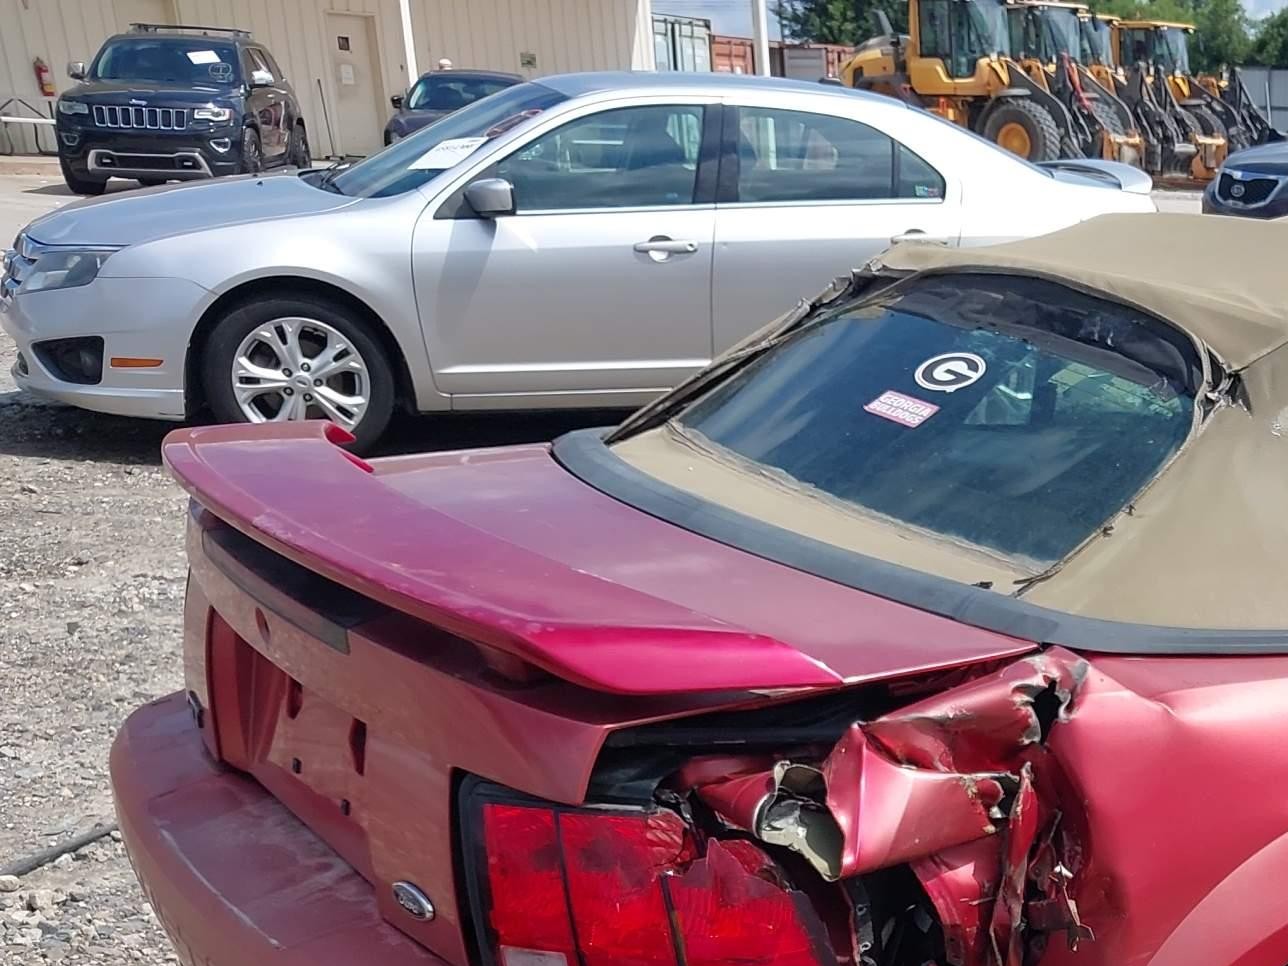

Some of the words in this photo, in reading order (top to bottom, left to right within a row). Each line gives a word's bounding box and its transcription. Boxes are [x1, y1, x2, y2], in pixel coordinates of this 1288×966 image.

[919, 355, 981, 388] G
[867, 402, 924, 425] BULLDOGS
[879, 394, 932, 417] GEORGIA
